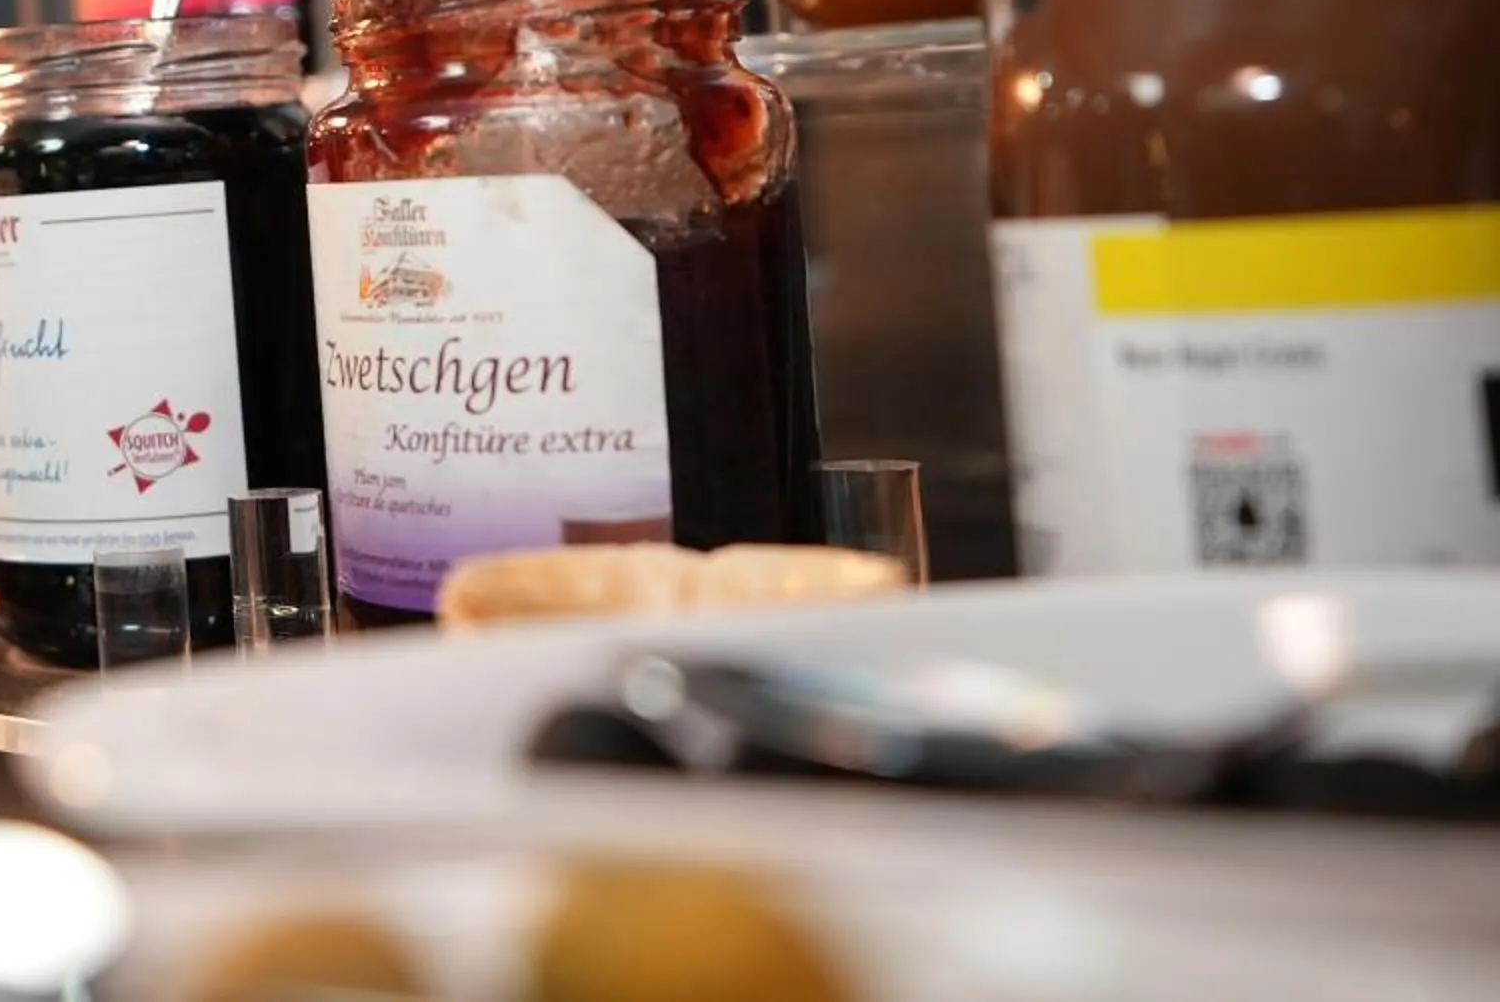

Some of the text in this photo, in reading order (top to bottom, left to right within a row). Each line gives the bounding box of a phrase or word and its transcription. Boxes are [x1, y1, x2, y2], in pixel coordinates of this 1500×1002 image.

[325, 337, 575, 416] Zwetschgen
[127, 432, 179, 452] SQUITCH
[383, 422, 636, 464] Konfitüre extra
